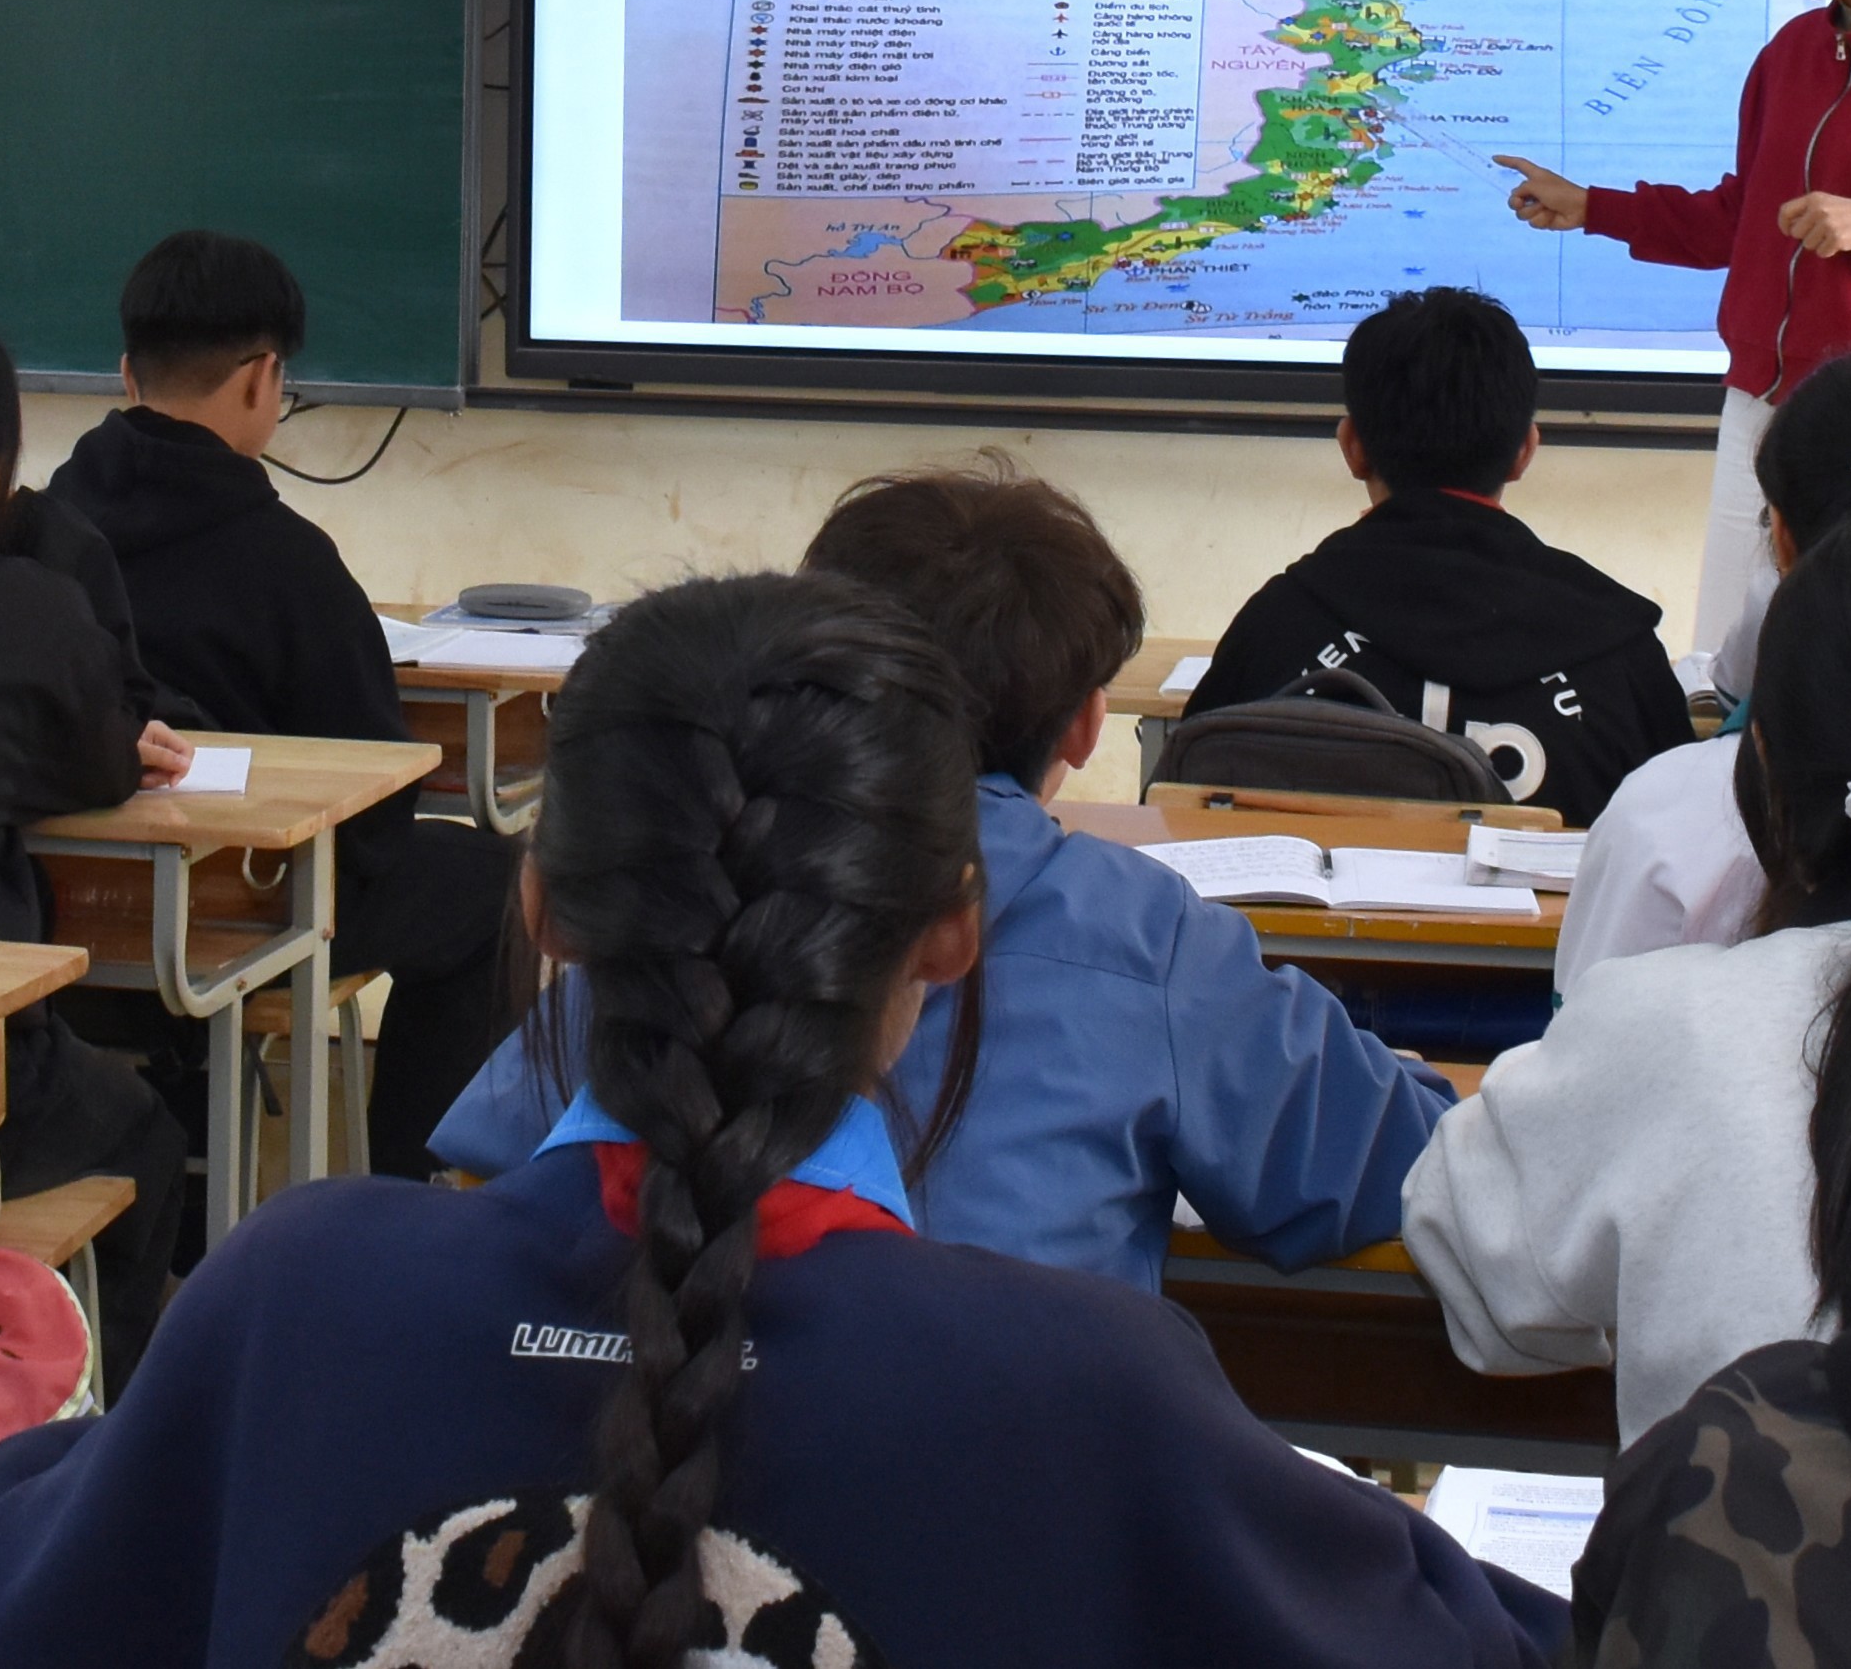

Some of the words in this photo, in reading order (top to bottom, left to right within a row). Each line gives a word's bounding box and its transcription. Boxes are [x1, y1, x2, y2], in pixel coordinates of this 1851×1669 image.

[1211, 59, 1306, 71] NGUYÊN
[830, 270, 912, 283] ĐÔNG
[816, 283, 881, 296] NAM
[887, 283, 924, 298] BỘ
